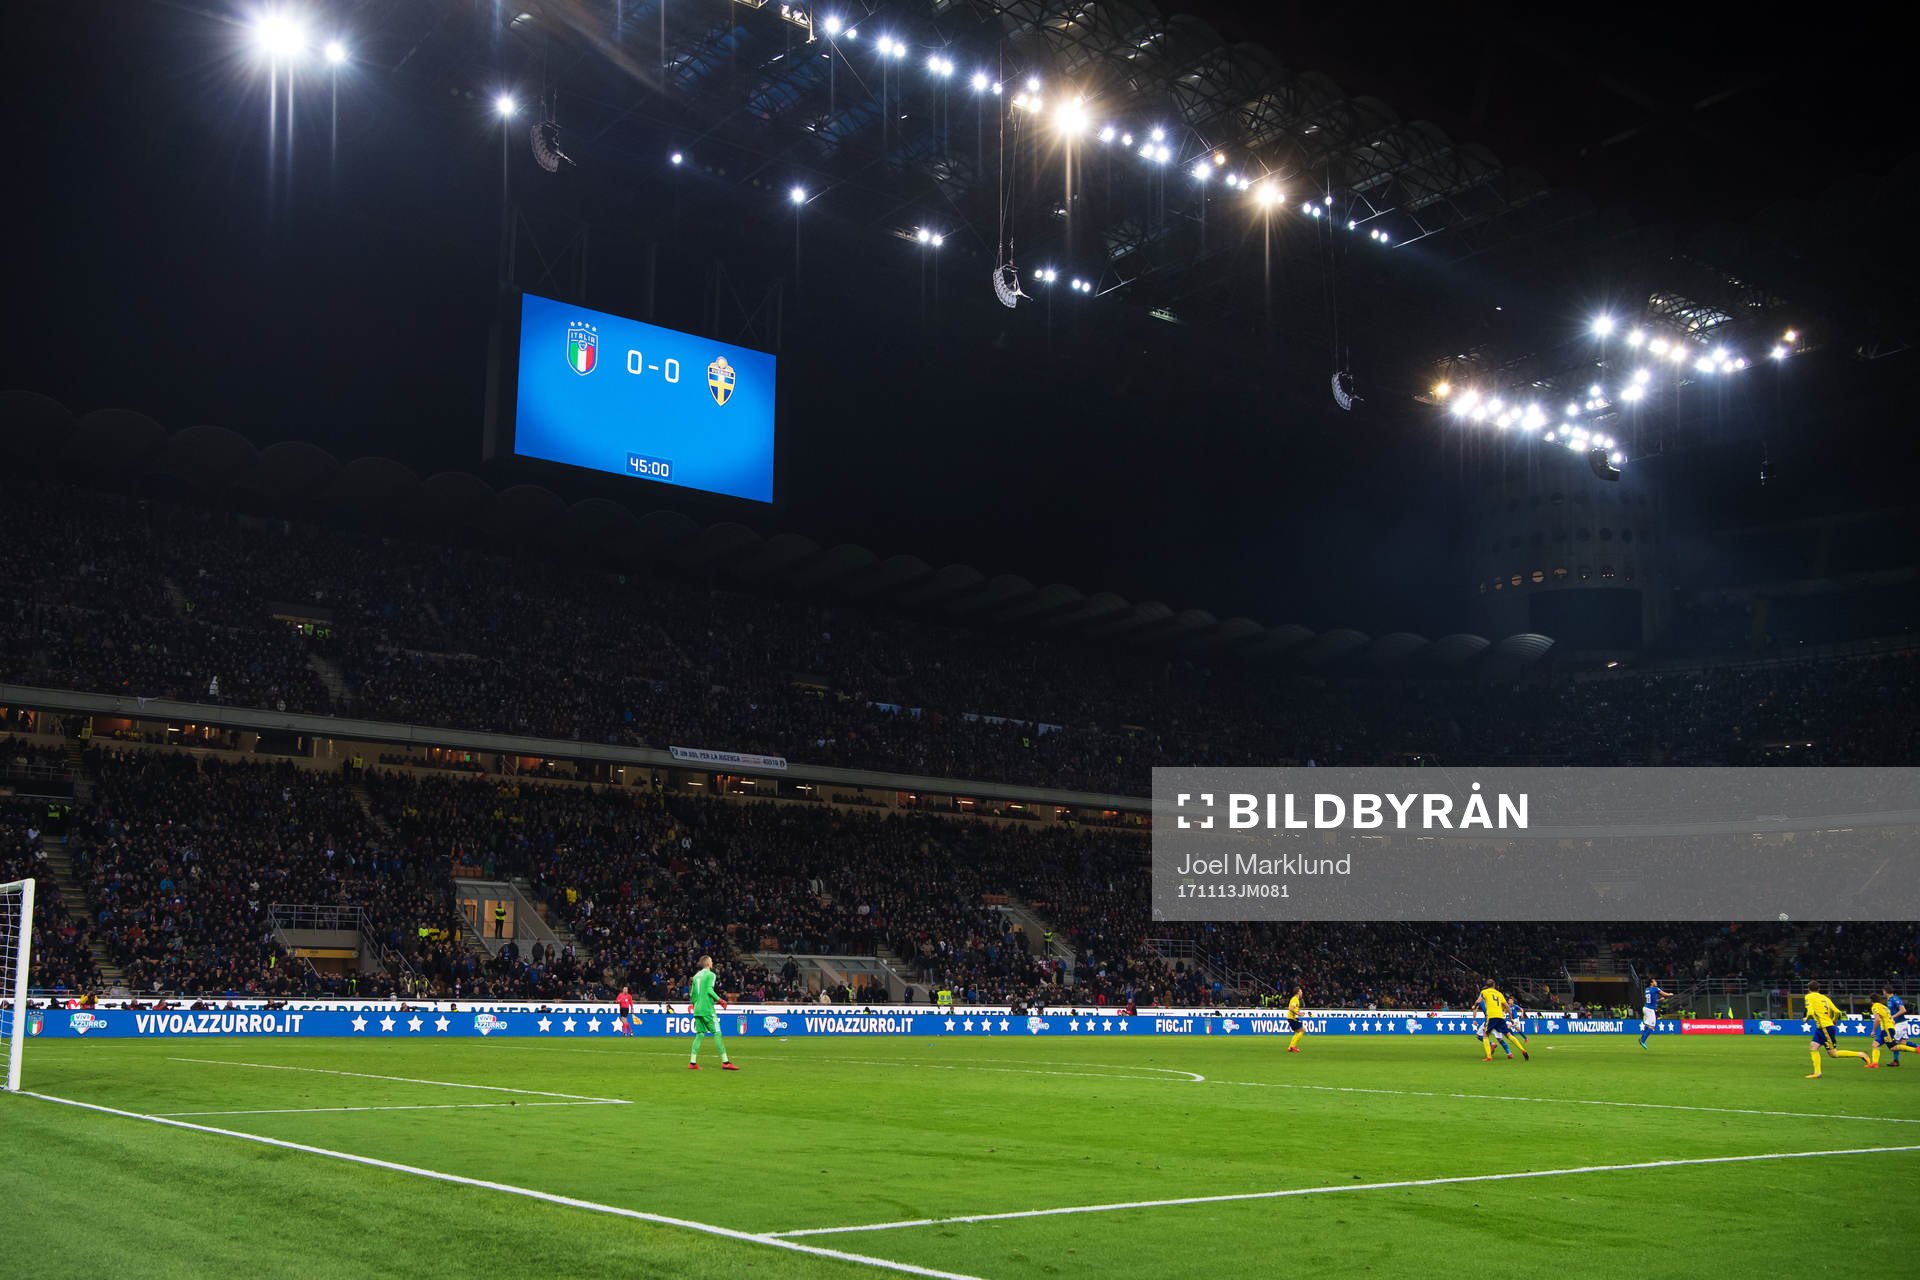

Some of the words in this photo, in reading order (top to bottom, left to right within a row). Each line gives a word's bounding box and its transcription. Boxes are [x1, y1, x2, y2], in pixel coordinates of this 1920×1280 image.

[570, 331, 596, 343] ITALIA
[630, 456, 670, 478] 45:00
[1492, 994, 1500, 1006] 4
[135, 1014, 304, 1034] VIVOAZZURRO.IT
[805, 1017, 914, 1033] VIVOAZZURRO.IT
[1155, 1019, 1194, 1033] FIGC.IT
[1251, 1019, 1328, 1033] VIVOAZZRO.IT
[1566, 1021, 1624, 1033] VIVOAZZURRO.IT
